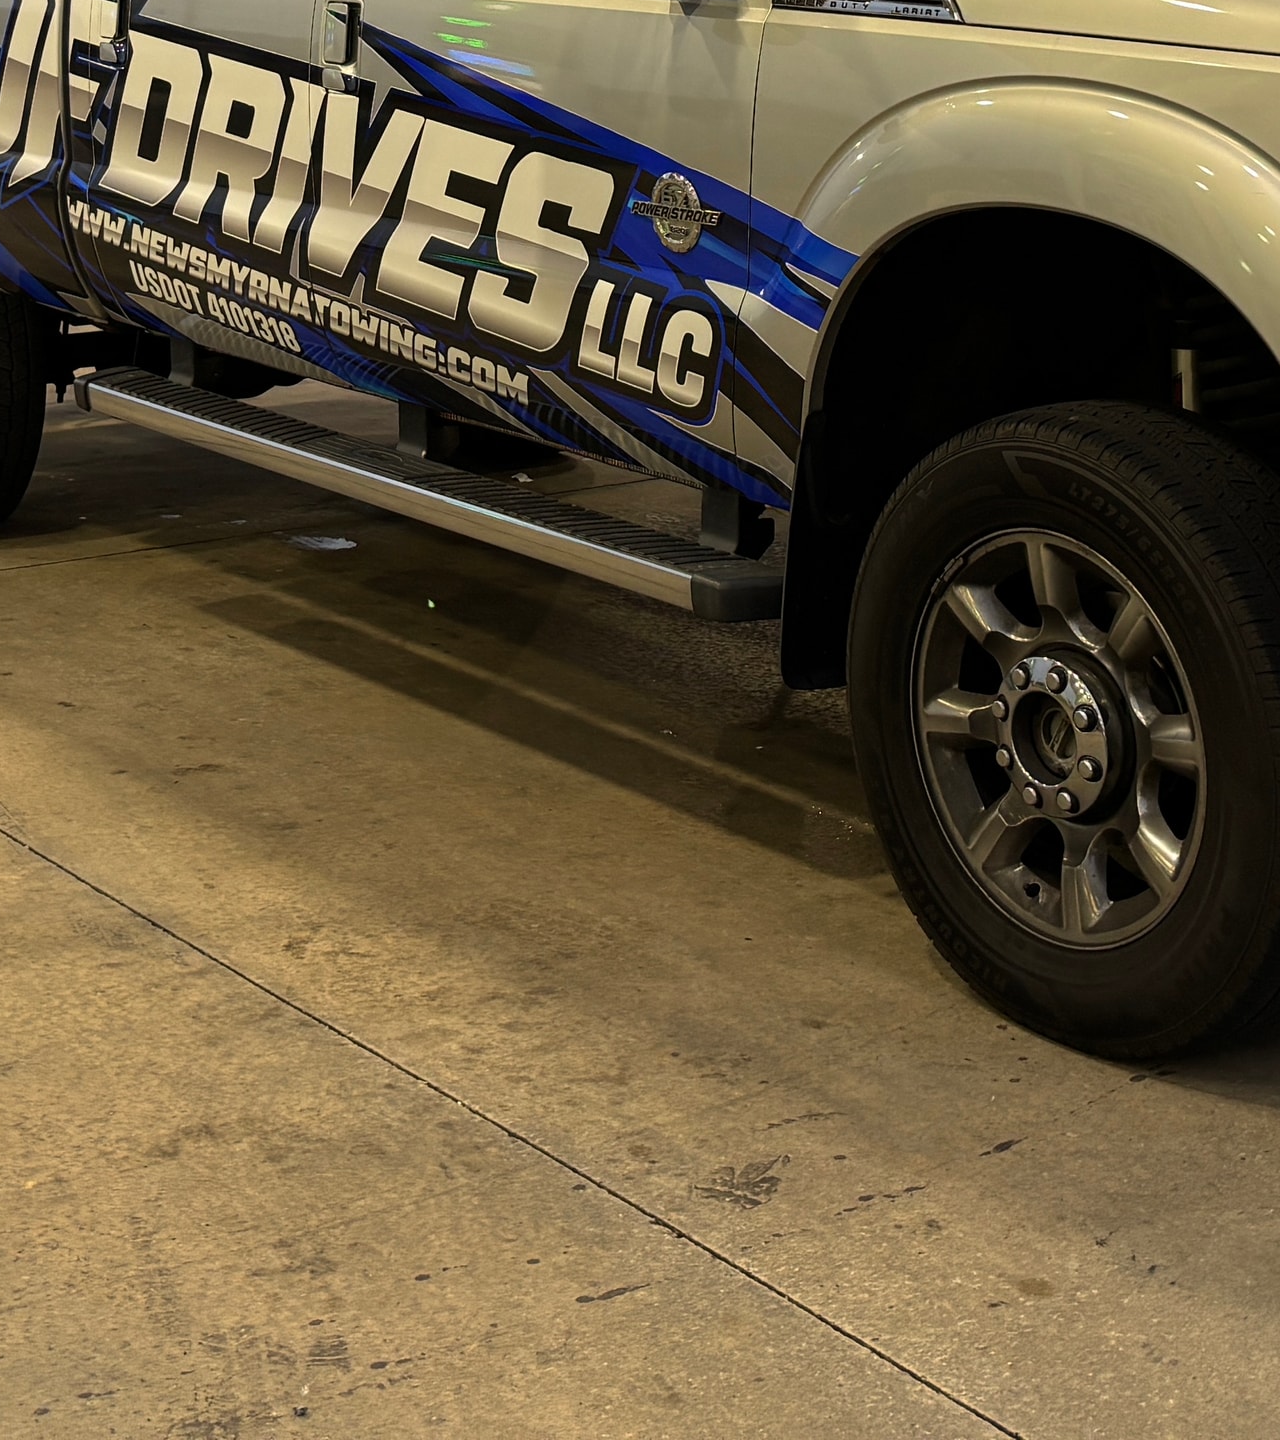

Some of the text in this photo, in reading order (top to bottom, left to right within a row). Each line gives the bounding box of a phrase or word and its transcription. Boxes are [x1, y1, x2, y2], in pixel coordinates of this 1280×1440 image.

[829, 0, 870, 10] DUTY
[894, 6, 942, 17] LARIAT
[99, 32, 615, 353] DRIVES
[631, 201, 721, 226] POWER STROKE
[129, 259, 302, 353] USDOT 4101318
[578, 279, 713, 407] LLC
